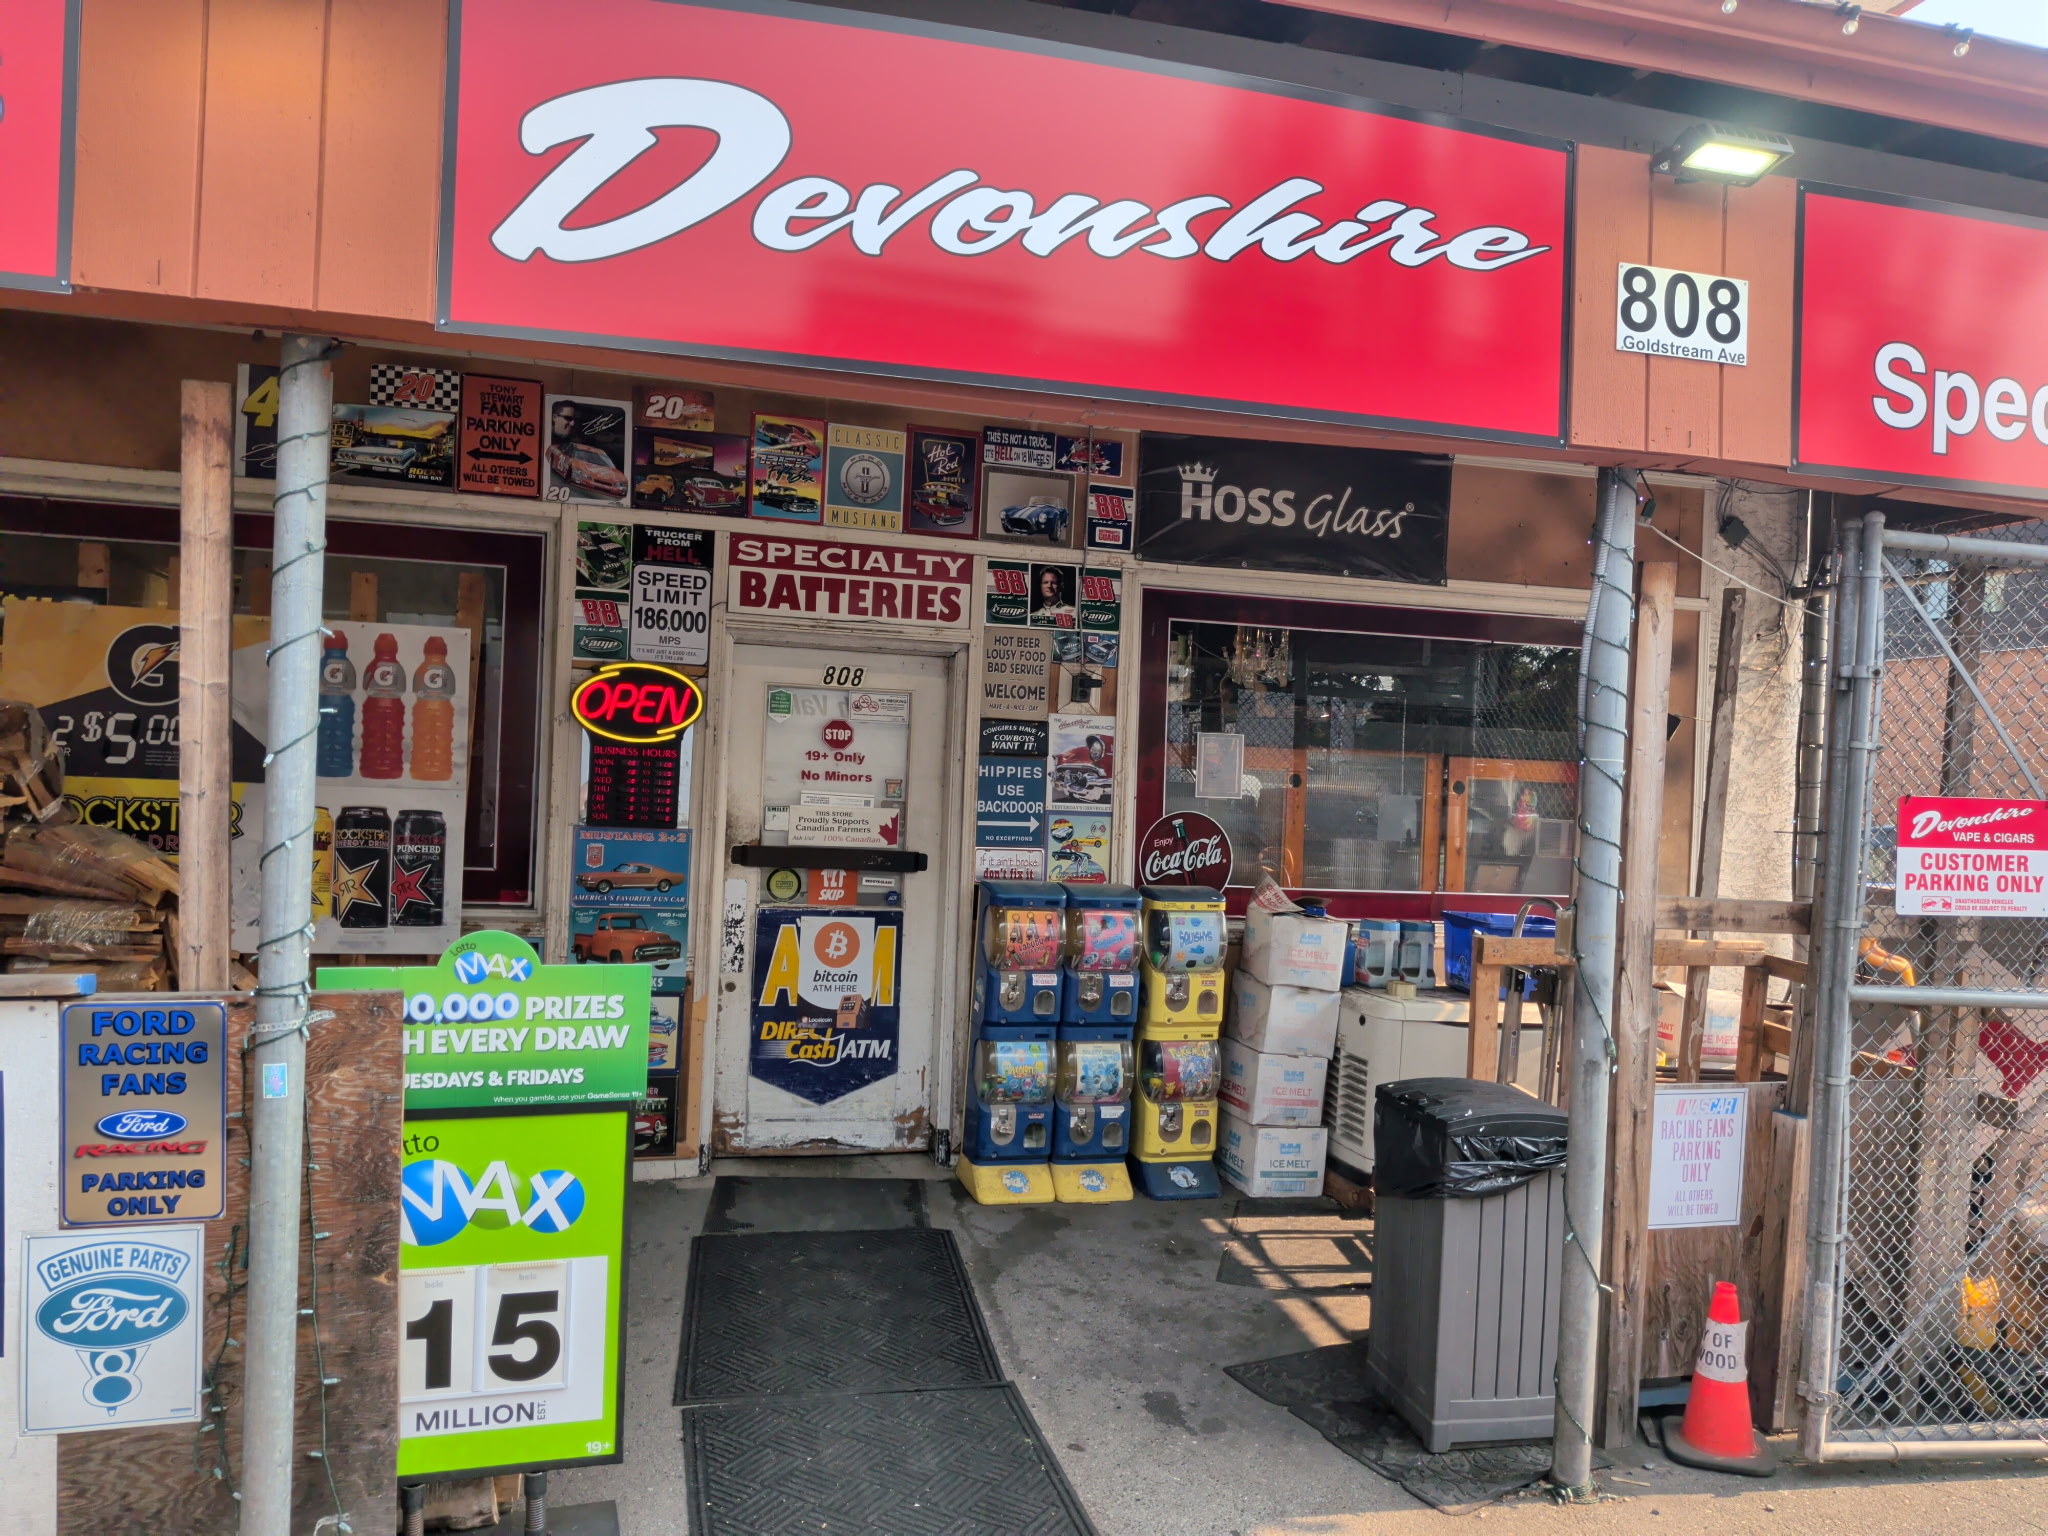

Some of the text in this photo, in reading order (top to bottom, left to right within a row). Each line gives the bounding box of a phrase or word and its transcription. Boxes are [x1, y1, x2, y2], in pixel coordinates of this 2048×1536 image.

[490, 76, 1553, 271] Devonshire
[1620, 267, 1741, 344] 808
[1623, 335, 1745, 364] Goldstream Ave
[394, 374, 436, 401] 20
[490, 384, 517, 393] TONY
[480, 392, 524, 404] STEWART
[480, 402, 522, 418] FANS
[645, 394, 685, 420] 20
[466, 417, 535, 436] PARKING
[479, 436, 521, 451] ONLY
[835, 429, 900, 450] CLASSIC
[987, 431, 1000, 442] THIS
[1002, 433, 1009, 443] IS
[1010, 433, 1022, 444] NOT
[1023, 435, 1027, 445] A
[985, 446, 1051, 466] IT'S HELL ON 18 WHEELS!
[471, 464, 528, 476] ALL OTHERS
[463, 473, 535, 487] WILL BE TOWED
[546, 486, 570, 501] 20
[1181, 482, 1408, 538] HOSS Glass
[831, 509, 896, 529] MUSTANG
[645, 530, 703, 541] TRUCKER
[657, 538, 691, 547] FROM
[647, 545, 700, 563] HELL
[736, 540, 967, 578] SPECIALTY
[637, 570, 707, 590] SPEED
[642, 588, 702, 606] LIMIT
[738, 570, 964, 623] BATTERIES
[634, 606, 707, 634] 186,000
[659, 635, 681, 645] MPS
[994, 636, 1041, 648] HOT BEER
[986, 649, 1046, 662] LOUSY FOOD
[823, 666, 864, 687] 808
[987, 662, 1044, 676] BAD SERVICE
[984, 683, 1046, 701] WELCOME
[579, 680, 691, 725] OPEN
[825, 729, 851, 741] STOP
[982, 725, 1017, 736] COWGIRLS
[1019, 726, 1037, 734] HAVE
[593, 745, 678, 758] BUSINESS HOURS
[991, 741, 1037, 751] WANT IT!
[805, 750, 866, 765] 19+ Only
[800, 770, 873, 782] No Minors
[978, 765, 1043, 779] HIPPIES
[997, 784, 1025, 796] USE
[977, 801, 1043, 814] BACKDOOR
[795, 824, 871, 834] Canadian Farmers
[798, 816, 870, 826] Proudly Supports
[1910, 807, 2034, 839] Devonshire
[579, 831, 687, 843] MUSTANG 2+2
[823, 834, 881, 844] 100% Canadian
[1153, 836, 1174, 849] Enjoy
[1953, 832, 2035, 844] VAPE & CIGARS
[396, 845, 441, 854] PUNCHED
[1144, 833, 1224, 882] Coca-Cola
[988, 857, 994, 866] it
[996, 857, 1013, 867] ain't
[1015, 854, 1038, 867] broke
[1920, 852, 2029, 873] CUSTOMER
[983, 867, 1034, 880] don't fix it
[1904, 873, 2045, 893] PARKING ONLY
[573, 894, 614, 902] AMERICA'S
[818, 889, 845, 901] SKIP
[449, 941, 477, 957] Lotto
[455, 952, 530, 984] MAX
[813, 970, 858, 983] bitcoin
[812, 984, 857, 992] ATM HERE
[525, 995, 625, 1021] PRIZES
[91, 1010, 196, 1037] FORD
[430, 1027, 530, 1054] EVERY
[534, 1024, 631, 1052] DRAW
[78, 1041, 209, 1066] RACING
[840, 1040, 891, 1058] ATM
[101, 1072, 188, 1097] FANS
[488, 1067, 585, 1087] & FRIDAYS
[529, 1094, 556, 1103] gamble,
[1272, 1088, 1313, 1097] ICE MELT
[1684, 1098, 1738, 1116] NASCAR
[1661, 1118, 1734, 1140] RACING FANS
[74, 1140, 209, 1159] RACING
[1673, 1140, 1721, 1162] PARKING
[1269, 1160, 1311, 1168] ICE MELT
[1682, 1162, 1711, 1183] ONLY
[81, 1168, 207, 1194] PARKING
[1674, 1189, 1714, 1203] ALL OTHERS
[107, 1194, 182, 1217] ONLY
[1668, 1203, 1719, 1217] WILL BE TOWED
[45, 1247, 183, 1284] GENUINE PARTS
[52, 1287, 174, 1335] Ford
[1713, 1333, 1732, 1349] OF
[415, 1401, 536, 1433] MILLION
[584, 1440, 611, 1455] 19+
